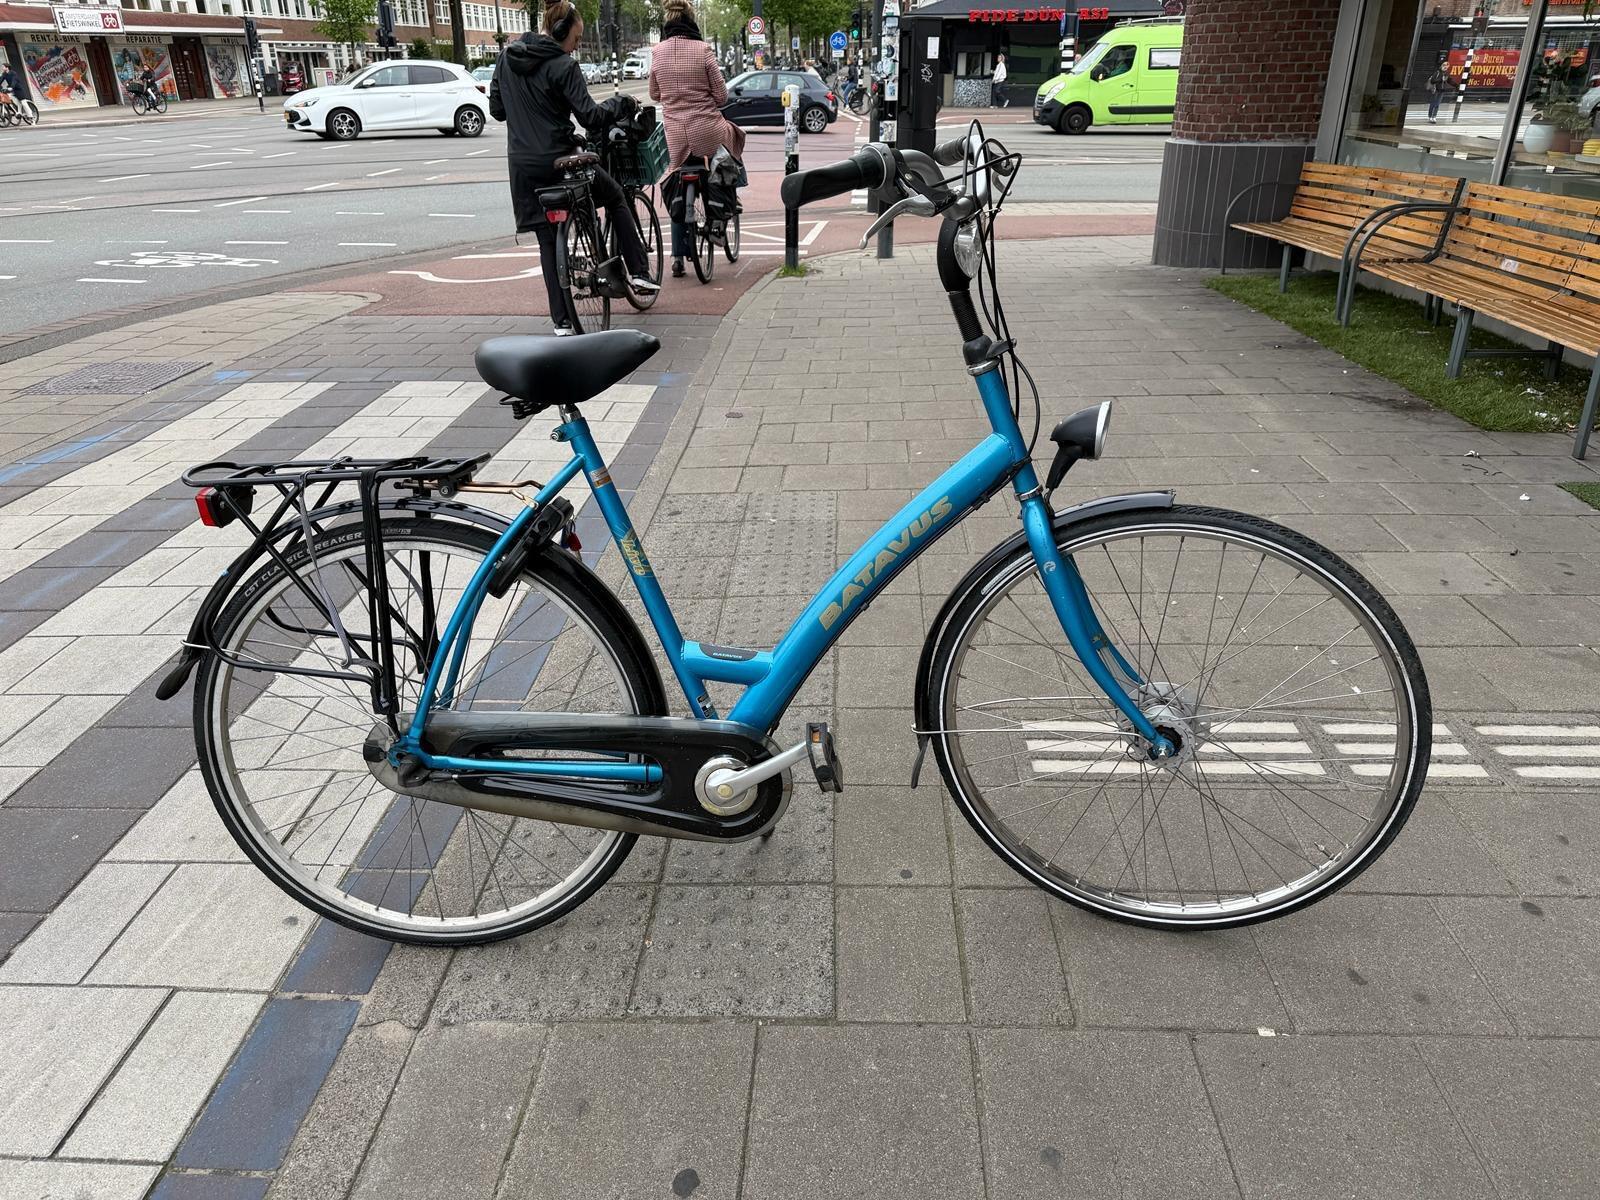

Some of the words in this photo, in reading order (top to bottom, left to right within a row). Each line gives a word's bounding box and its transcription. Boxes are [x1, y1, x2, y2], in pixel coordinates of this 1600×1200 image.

[968, 8, 1020, 22] PIDE
[1023, 6, 1109, 22] DÜNASI
[66, 20, 102, 28] FIETSWINKEL
[752, 22, 761, 30] 30
[125, 36, 162, 44] REPARATIE
[1483, 53, 1505, 64] Buren
[1450, 65, 1518, 76] AVNDWINKE
[1483, 78, 1495, 86] 102
[244, 581, 260, 597] CST
[262, 551, 305, 582] CLASIC
[307, 532, 363, 553] REAKER
[818, 495, 954, 632] BATAVUS
